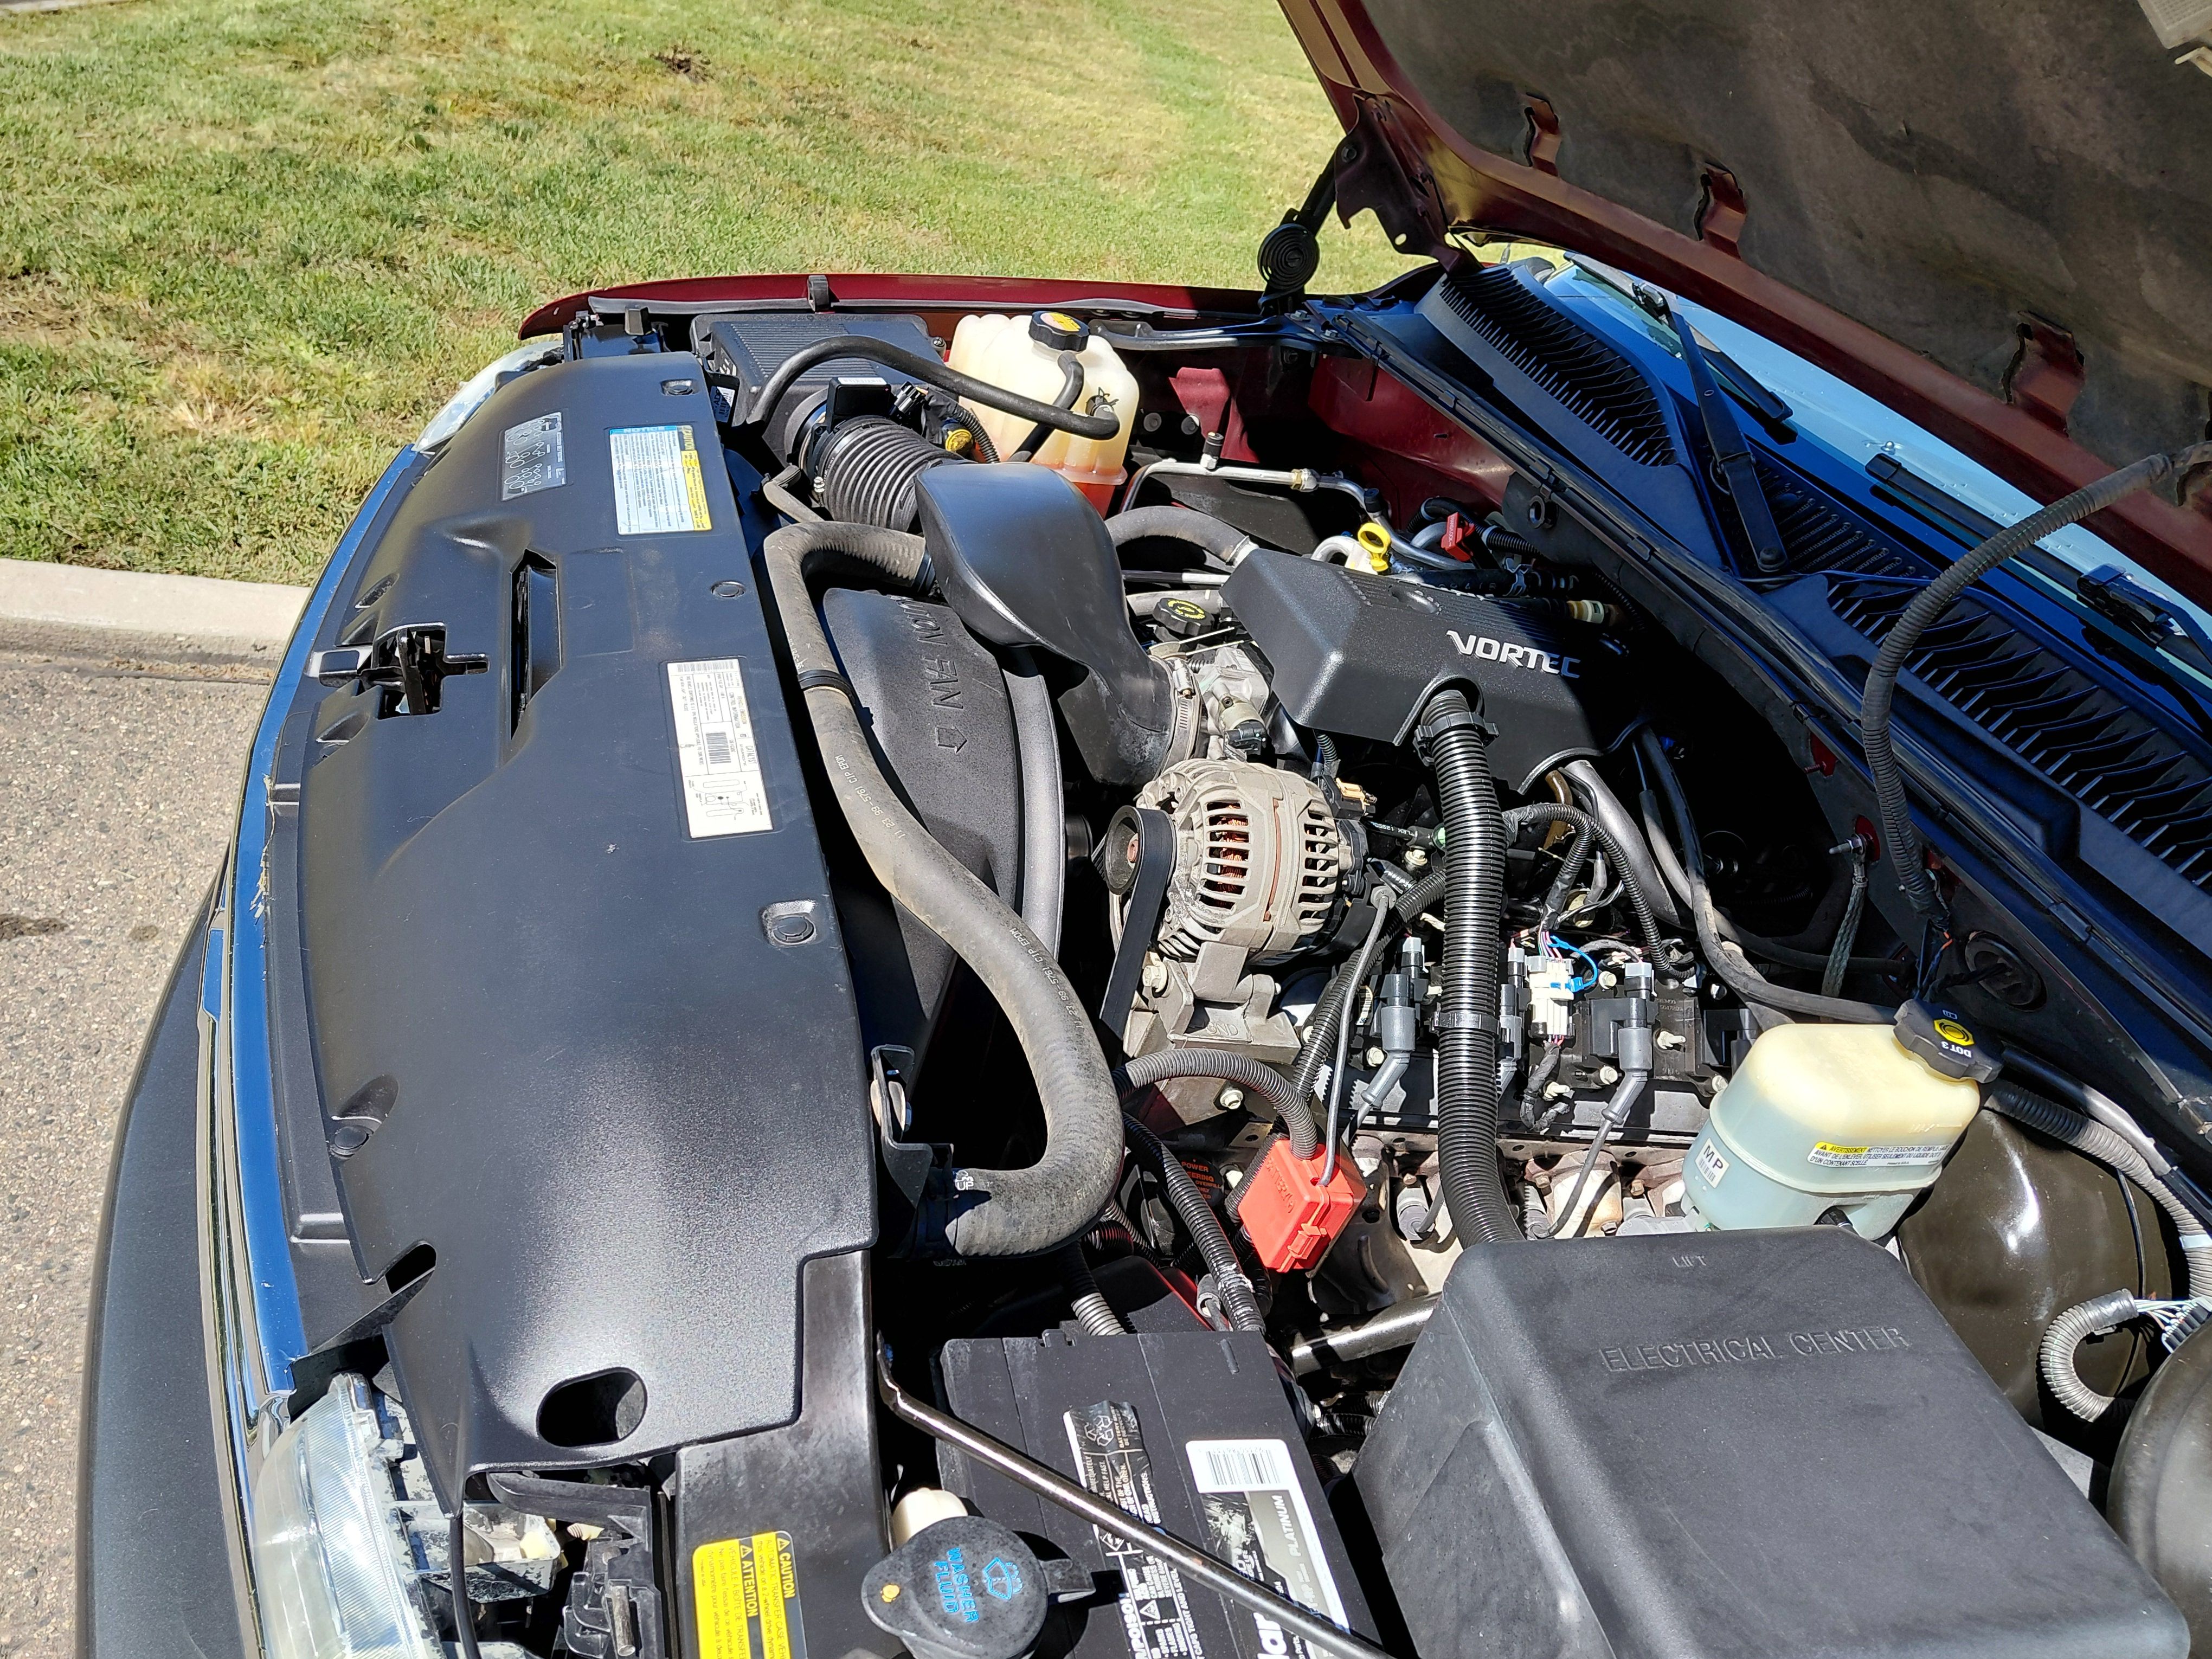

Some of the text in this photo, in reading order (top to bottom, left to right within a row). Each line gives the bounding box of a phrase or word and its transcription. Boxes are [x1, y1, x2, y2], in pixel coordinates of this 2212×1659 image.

[1446, 629, 1581, 678] VORTEC
[921, 658, 964, 710] FAN
[744, 745, 756, 765] CATALYST
[832, 754, 851, 770] EPDM
[843, 770, 859, 783] CIP
[853, 785, 884, 816] 99-5761
[880, 816, 896, 828] 23
[1008, 926, 1031, 947] EPDM
[1026, 947, 1045, 963] CIP
[1041, 965, 1070, 1002] 99-5761
[1065, 1005, 1077, 1015] 23
[1939, 1040, 1973, 1058] DOT 3
[1180, 1161, 1210, 1173] POWER
[956, 1181, 974, 1191] UP
[1599, 1326, 1912, 1373] ELECTRICAL CENTER
[1098, 1461, 1108, 1474] FAST.
[1102, 1476, 1111, 1489] HELP
[1139, 1471, 1161, 1523] INSTRUCTIONS.
[1268, 1495, 1304, 1556] PLATINUM
[718, 1548, 725, 1557] Ne
[766, 1539, 777, 1580] AUTOMATIC
[1240, 1549, 1251, 1561] LIFE
[779, 1552, 796, 1599] CAUTION
[946, 1546, 981, 1625] WASHER
[1141, 1566, 1158, 1598] CAN CAUSE
[1159, 1574, 1173, 1597] SEVERE
[1169, 1569, 1183, 1591] LEVEL
[741, 1560, 758, 1618] ATTENTION
[931, 1558, 961, 1615] FLUID
[771, 1582, 782, 1619] TRANSFER
[1176, 1593, 1189, 1609] AND
[736, 1612, 743, 1622] DE
[1181, 1610, 1196, 1632] TIGHT
[776, 1621, 785, 1641] CASE
[1188, 1634, 1203, 1654] CAPS
